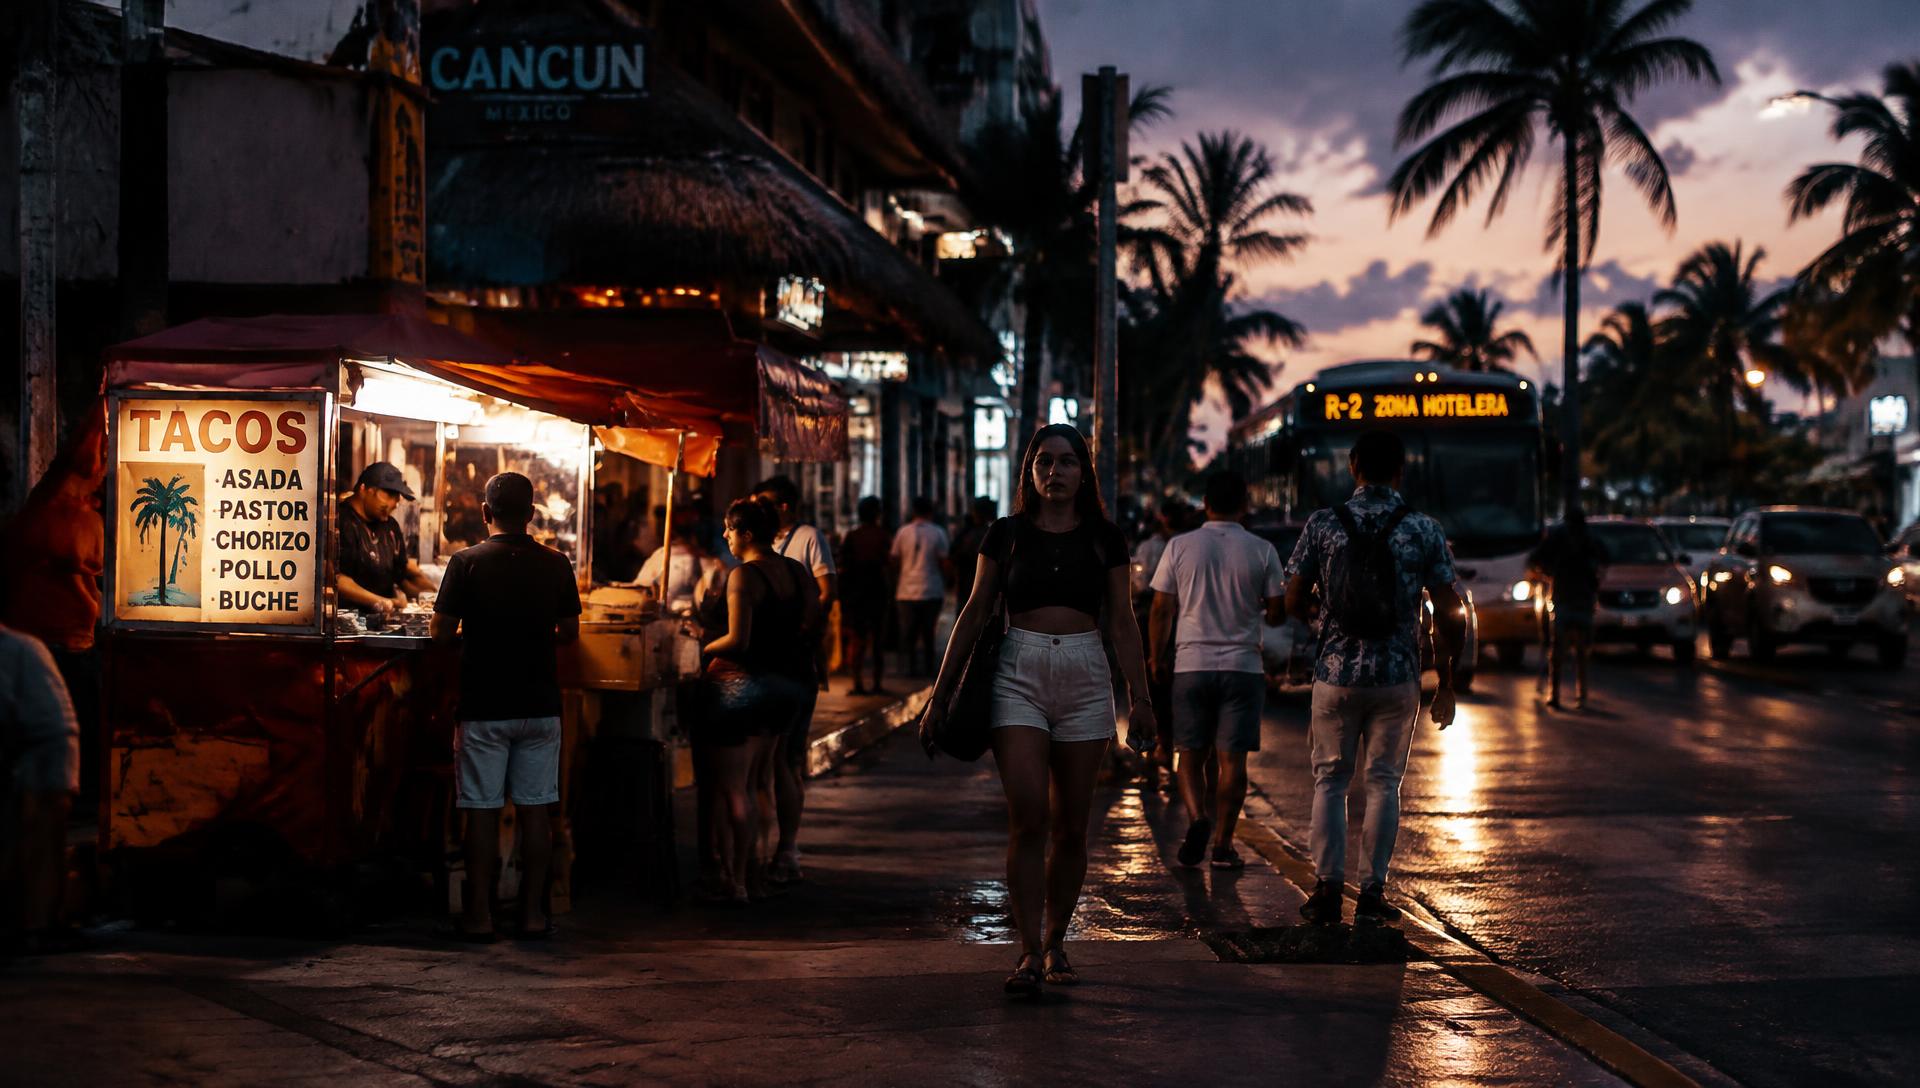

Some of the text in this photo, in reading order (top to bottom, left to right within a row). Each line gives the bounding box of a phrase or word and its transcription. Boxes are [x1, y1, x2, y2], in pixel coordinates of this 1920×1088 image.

[430, 45, 645, 91] CANCUN
[484, 103, 571, 121] MEXICO
[1325, 393, 1363, 420] R-2
[1373, 394, 1419, 418] ZONA
[130, 409, 307, 454] TACOS
[221, 469, 303, 490] ASADA
[219, 500, 308, 521] PASTOR
[215, 530, 310, 551] CHORIZO
[219, 559, 297, 581] POLLO
[219, 590, 299, 611] BUCHE
